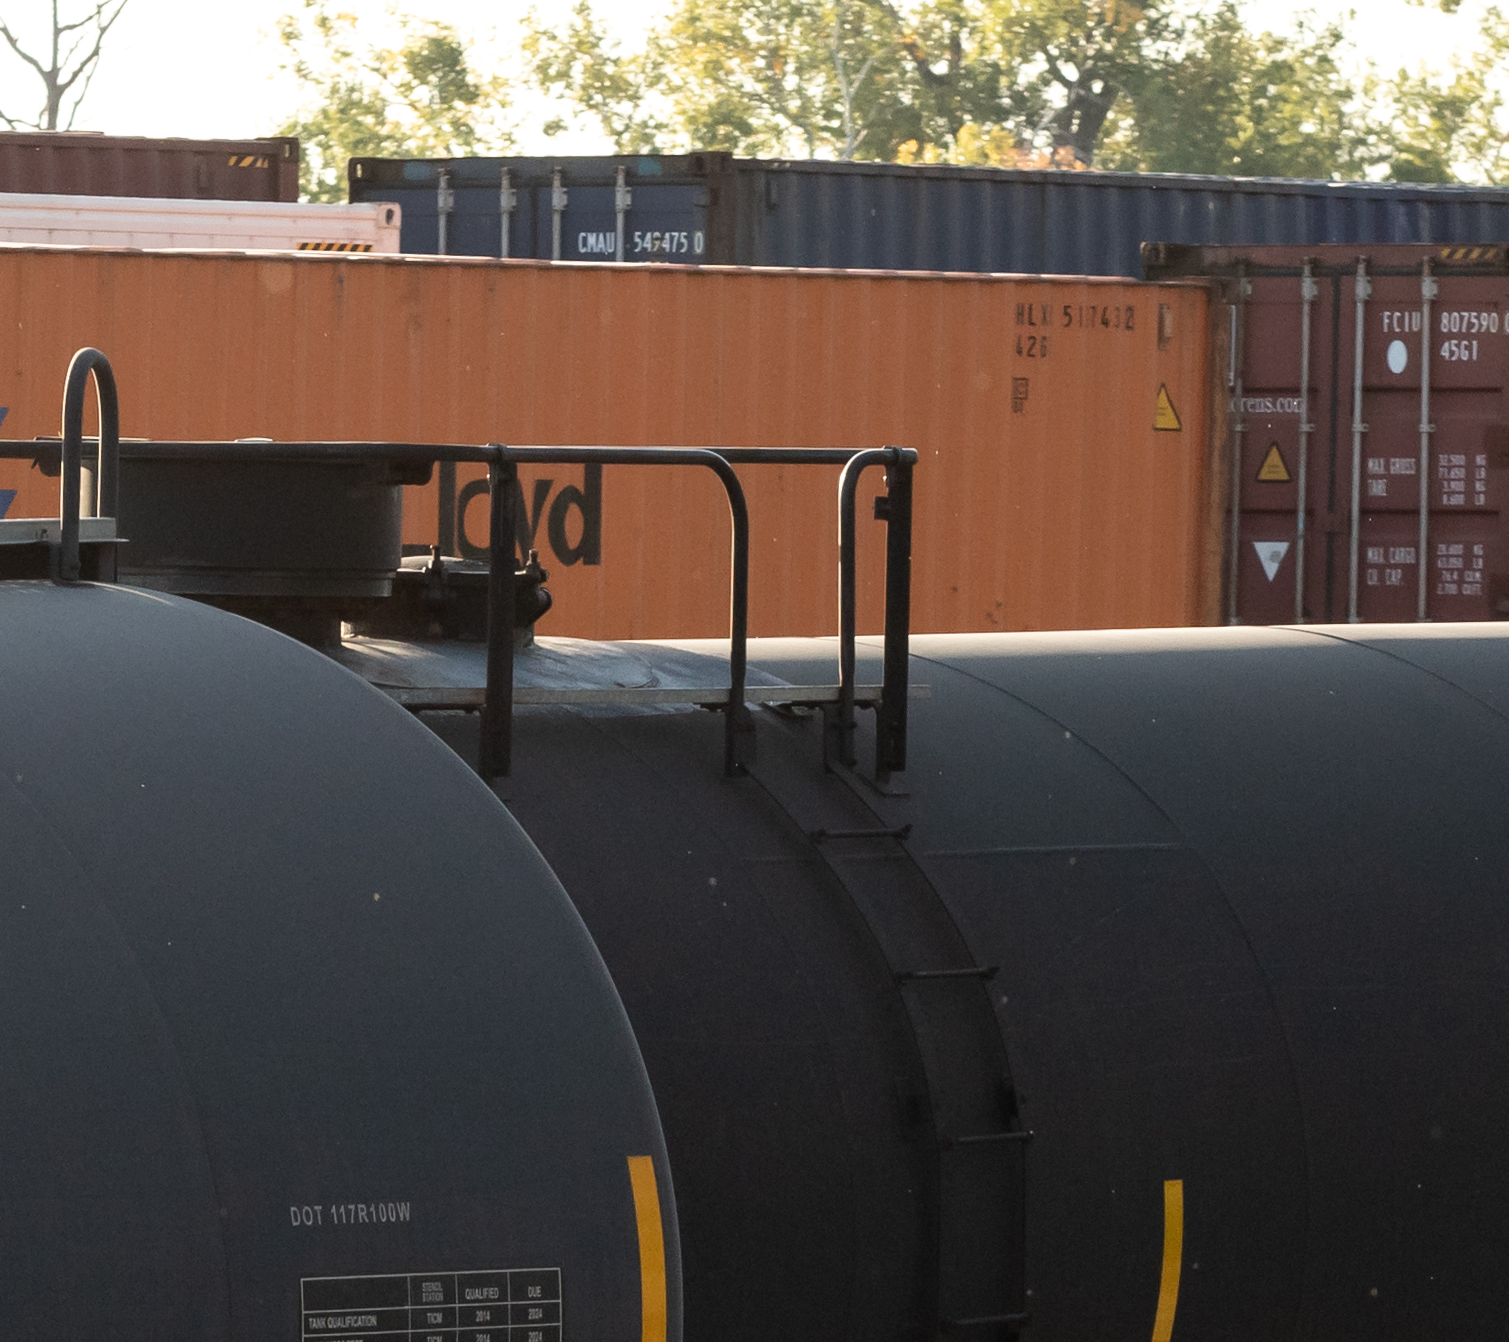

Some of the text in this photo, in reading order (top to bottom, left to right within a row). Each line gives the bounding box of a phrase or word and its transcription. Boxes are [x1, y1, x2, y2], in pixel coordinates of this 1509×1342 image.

[578, 231, 616, 253] CMAU
[1438, 311, 1499, 334] 807590
[1438, 339, 1479, 361] 45G1
[291, 1202, 410, 1226] DOT 117R100W
[465, 1287, 499, 1300] QUALIFIED
[528, 1286, 542, 1297] DUE
[476, 1311, 490, 1322] 2014
[529, 1309, 543, 1319] 2024
[309, 1315, 377, 1329] TANK QUALIFICATION
[529, 1332, 543, 1342] 2024
